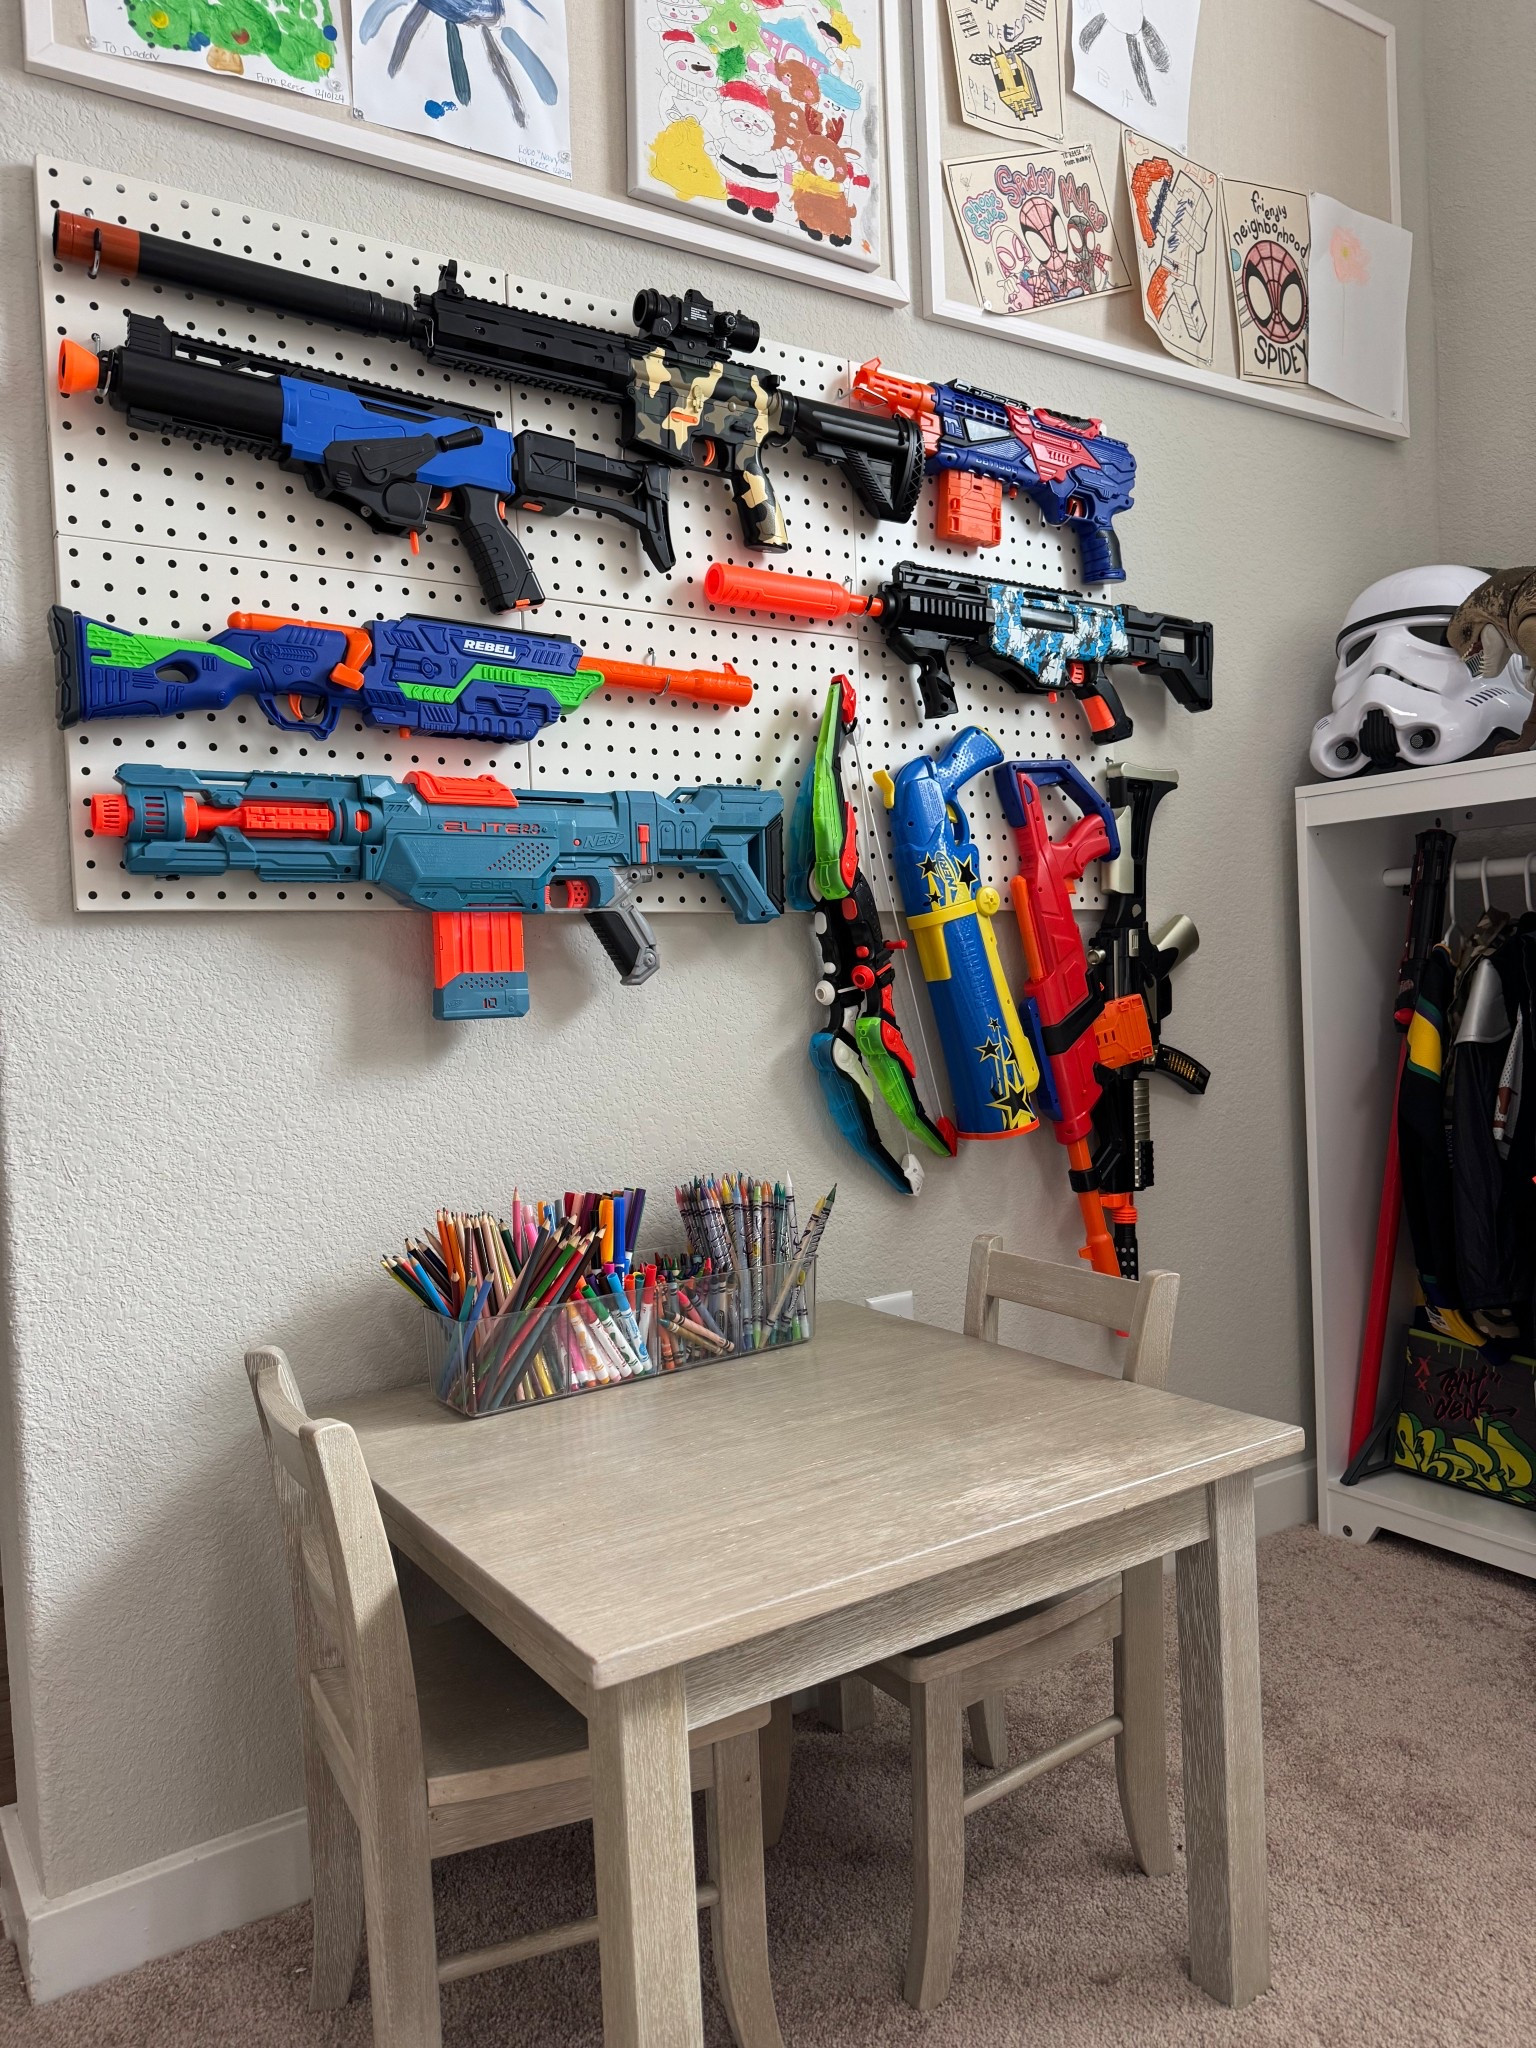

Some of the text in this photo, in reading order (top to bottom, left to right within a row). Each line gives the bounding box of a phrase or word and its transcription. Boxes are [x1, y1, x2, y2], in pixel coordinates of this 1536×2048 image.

[123, 46, 160, 61] Daddy
[1251, 190, 1287, 222] friendly
[1233, 217, 1310, 259] neighborhood
[1254, 335, 1309, 377] SPIDEY
[463, 639, 513, 655] REBEL
[443, 820, 521, 835] ELITE
[583, 831, 625, 850] NERF
[470, 879, 513, 890] ECHO
[483, 997, 498, 1009] 10
